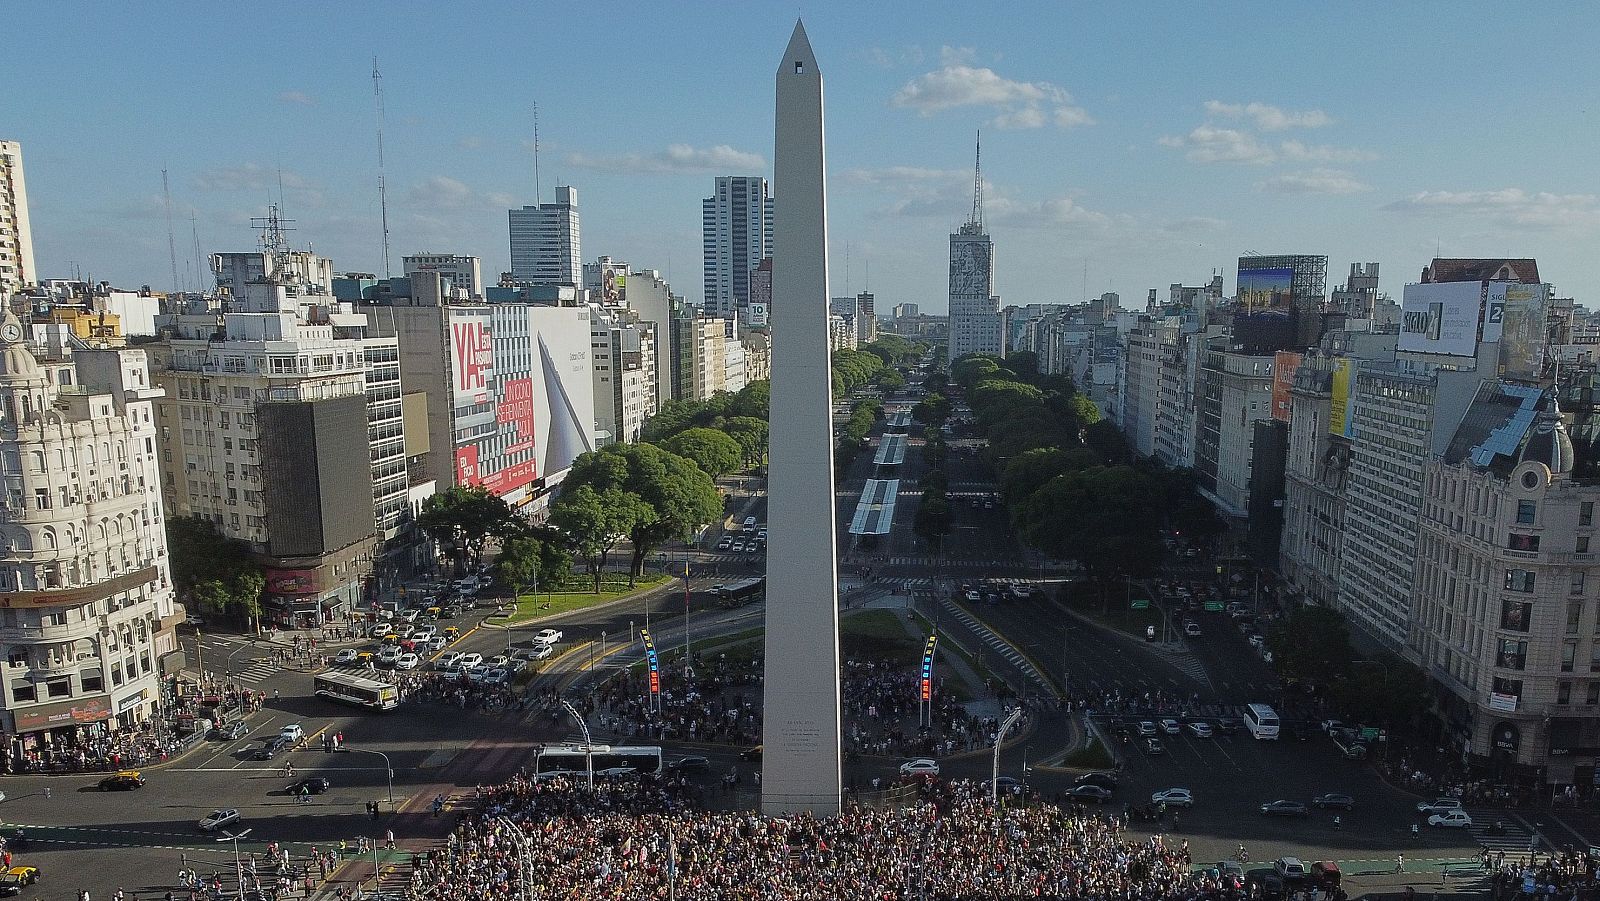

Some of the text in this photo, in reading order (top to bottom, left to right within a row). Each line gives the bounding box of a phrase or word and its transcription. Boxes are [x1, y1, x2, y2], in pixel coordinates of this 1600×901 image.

[752, 306, 764, 314] 10
[1402, 311, 1428, 334] SIGLO
[497, 404, 506, 423] SE
[1497, 741, 1514, 749] BBVA
